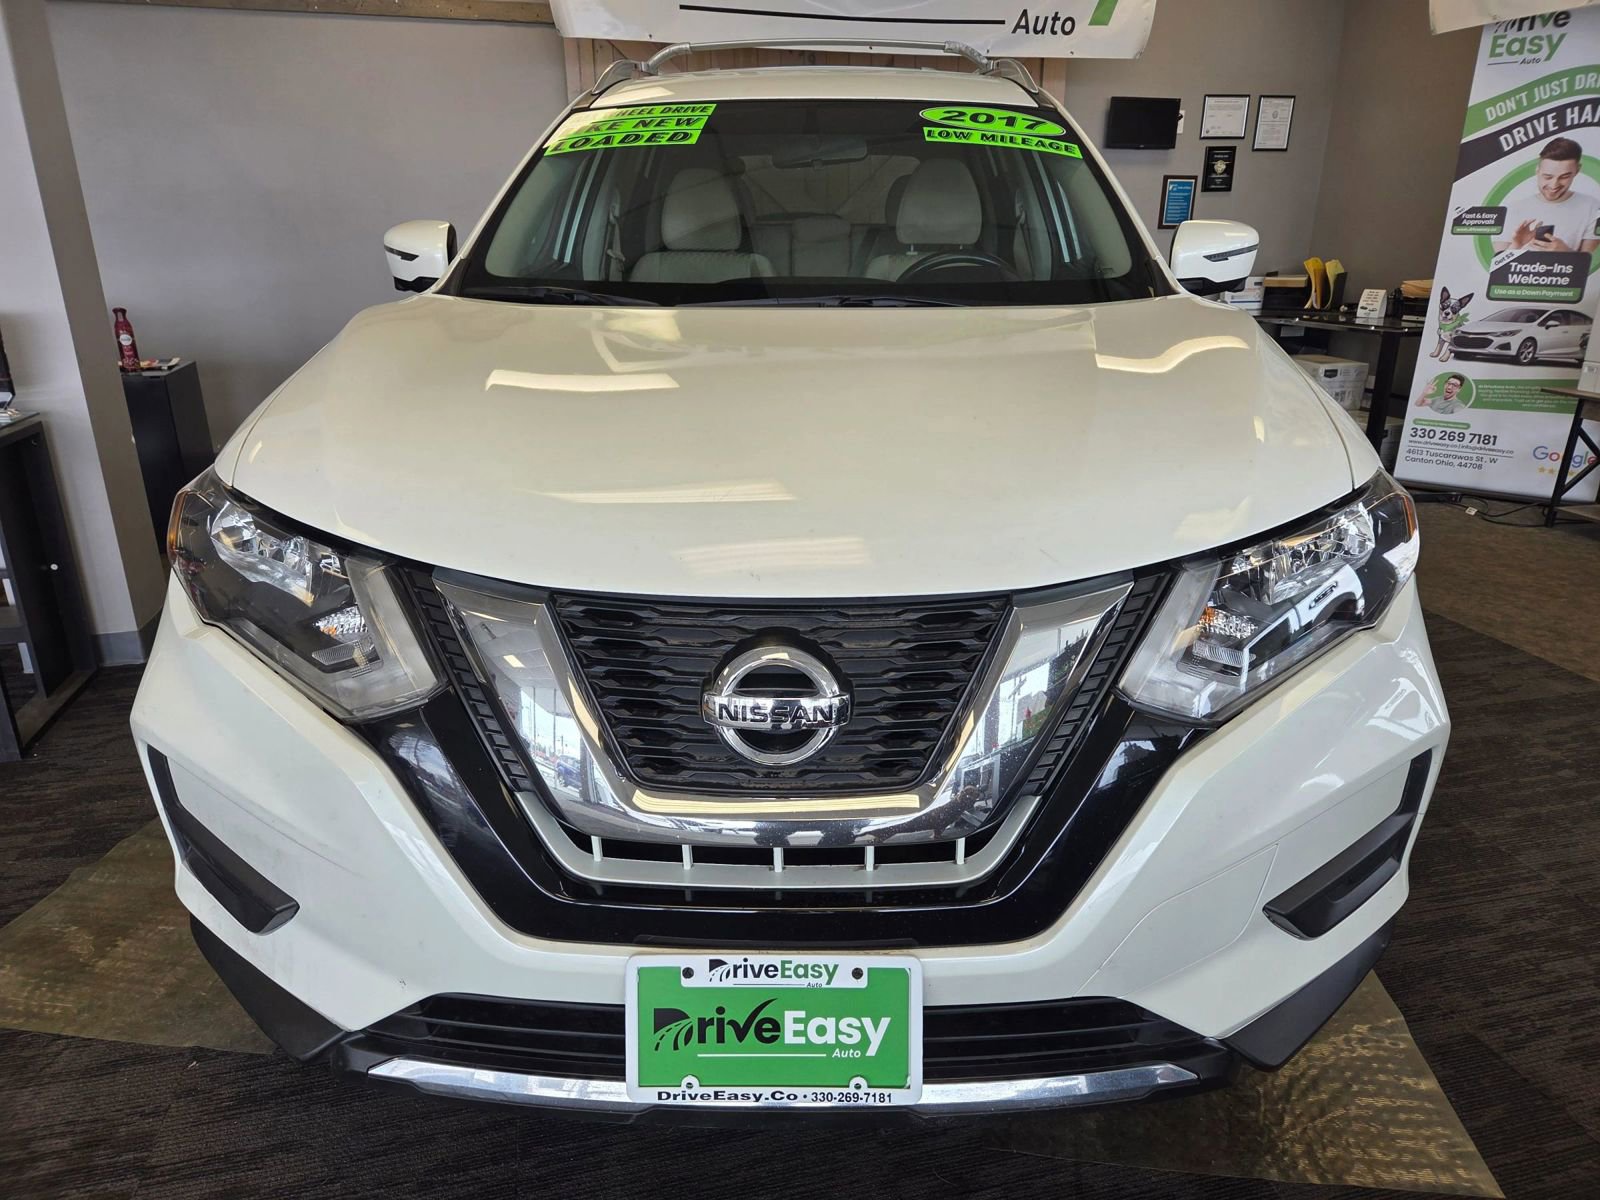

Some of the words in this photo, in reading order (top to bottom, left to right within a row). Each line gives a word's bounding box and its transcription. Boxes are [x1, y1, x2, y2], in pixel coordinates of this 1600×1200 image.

[1011, 8, 1076, 37] Auto
[1488, 33, 1568, 62] Easy
[1519, 57, 1542, 65] Auto
[1485, 91, 1529, 122] DON'T
[1533, 76, 1570, 103] JUST
[660, 104, 712, 115] DRIVE
[632, 116, 704, 129] NEW
[939, 110, 1048, 131] 2017
[1498, 111, 1559, 152] DRIVE
[549, 131, 693, 153] LOADED
[926, 129, 973, 141] LOW
[980, 132, 1078, 153] MILEAGE
[1509, 262, 1574, 274] Trade-Ins
[1508, 274, 1570, 285] Welcome
[1542, 290, 1574, 298] Payment
[1409, 427, 1437, 440] 330
[1438, 430, 1466, 443] 269
[1468, 433, 1498, 446] 7181
[1406, 448, 1424, 456] 4613
[1425, 450, 1475, 462] Tuscarawas
[1405, 456, 1434, 465] Canton
[1457, 461, 1483, 471] 44708
[717, 703, 834, 724] NISSAN
[832, 1047, 861, 1059] Auto
[656, 1089, 798, 1103] DriveEasy.Co
[810, 1091, 893, 1104] 330-269-7181
